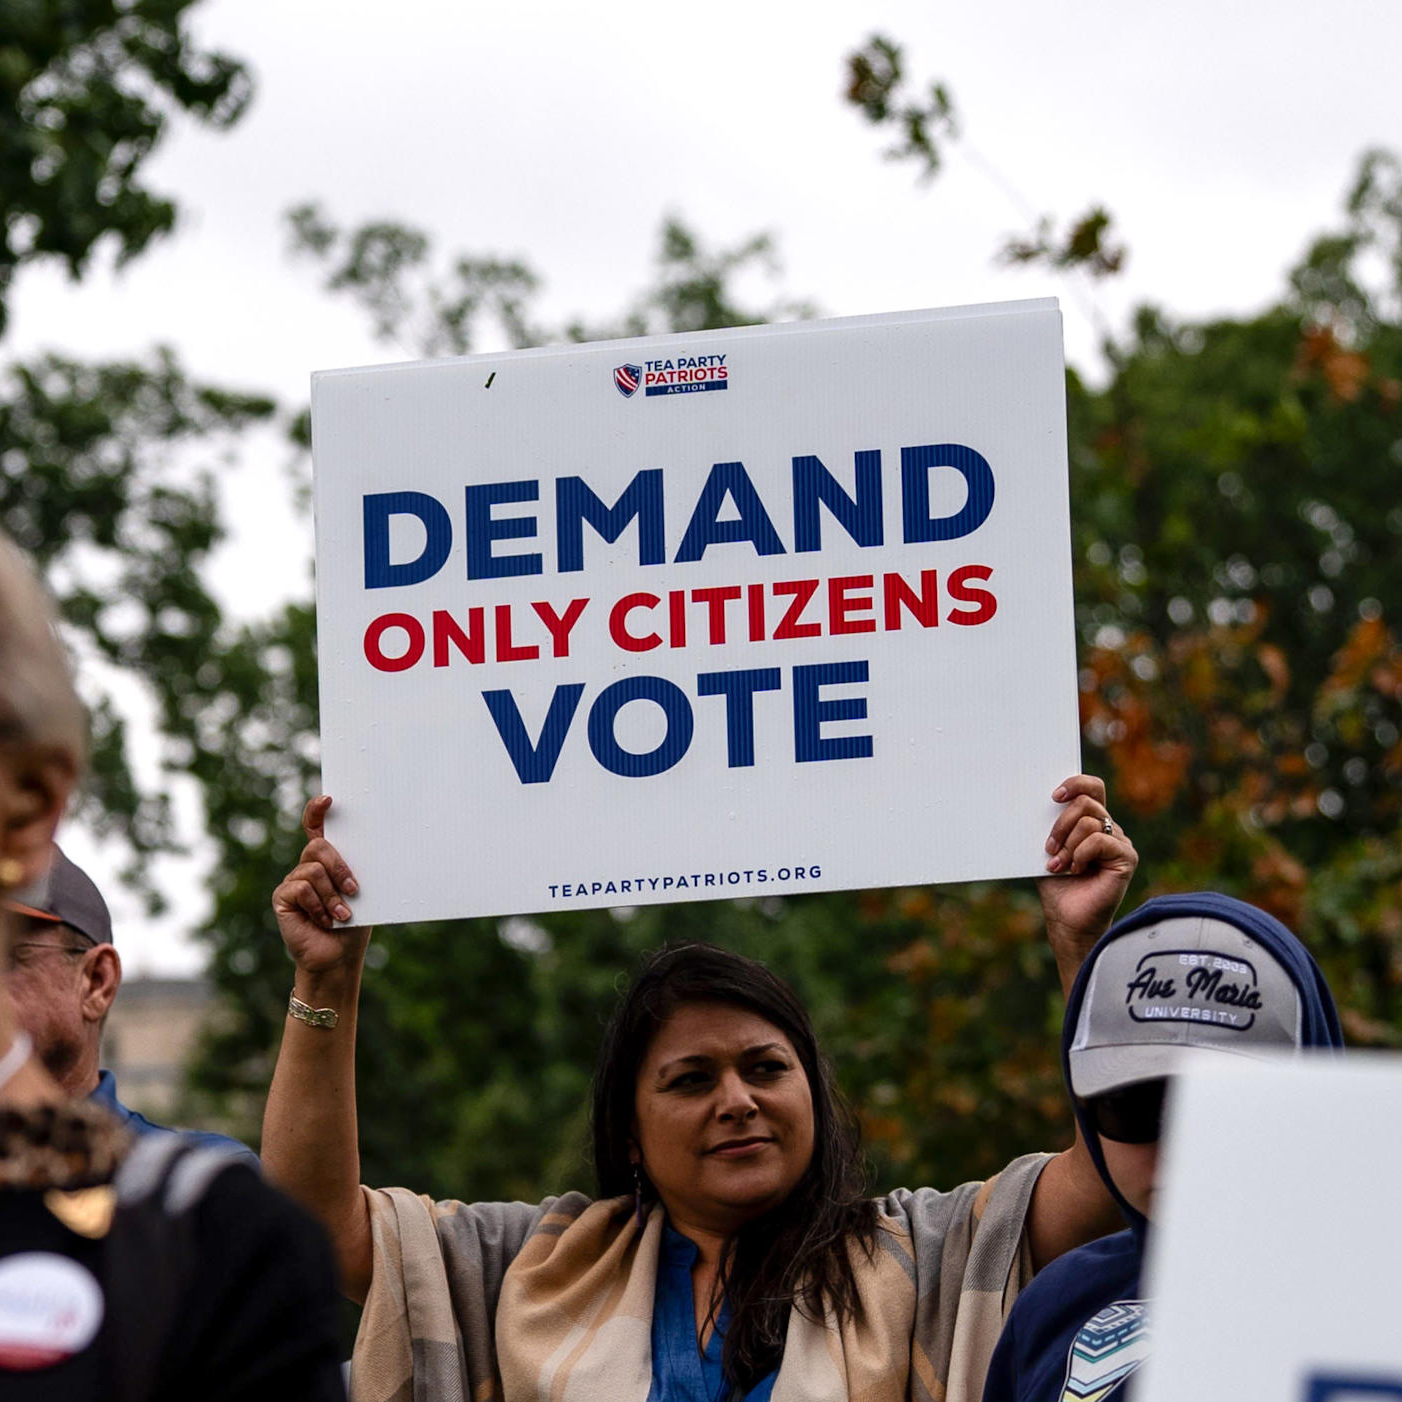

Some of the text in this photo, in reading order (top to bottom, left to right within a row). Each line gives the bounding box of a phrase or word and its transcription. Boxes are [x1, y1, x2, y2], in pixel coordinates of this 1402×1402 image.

[645, 354, 727, 372] TEA PARTY
[645, 366, 729, 386] PATRIOTS
[666, 383, 706, 394] ACTION
[362, 443, 996, 590] DEMAND
[363, 564, 998, 673] ONLY CITIZENS
[481, 660, 874, 785] VOTE
[548, 865, 823, 899] TEAPARTYPATRIOTS.ORG
[1126, 966, 1263, 1010] Ave Maria
[1144, 1006, 1238, 1025] UNIVERSITY
